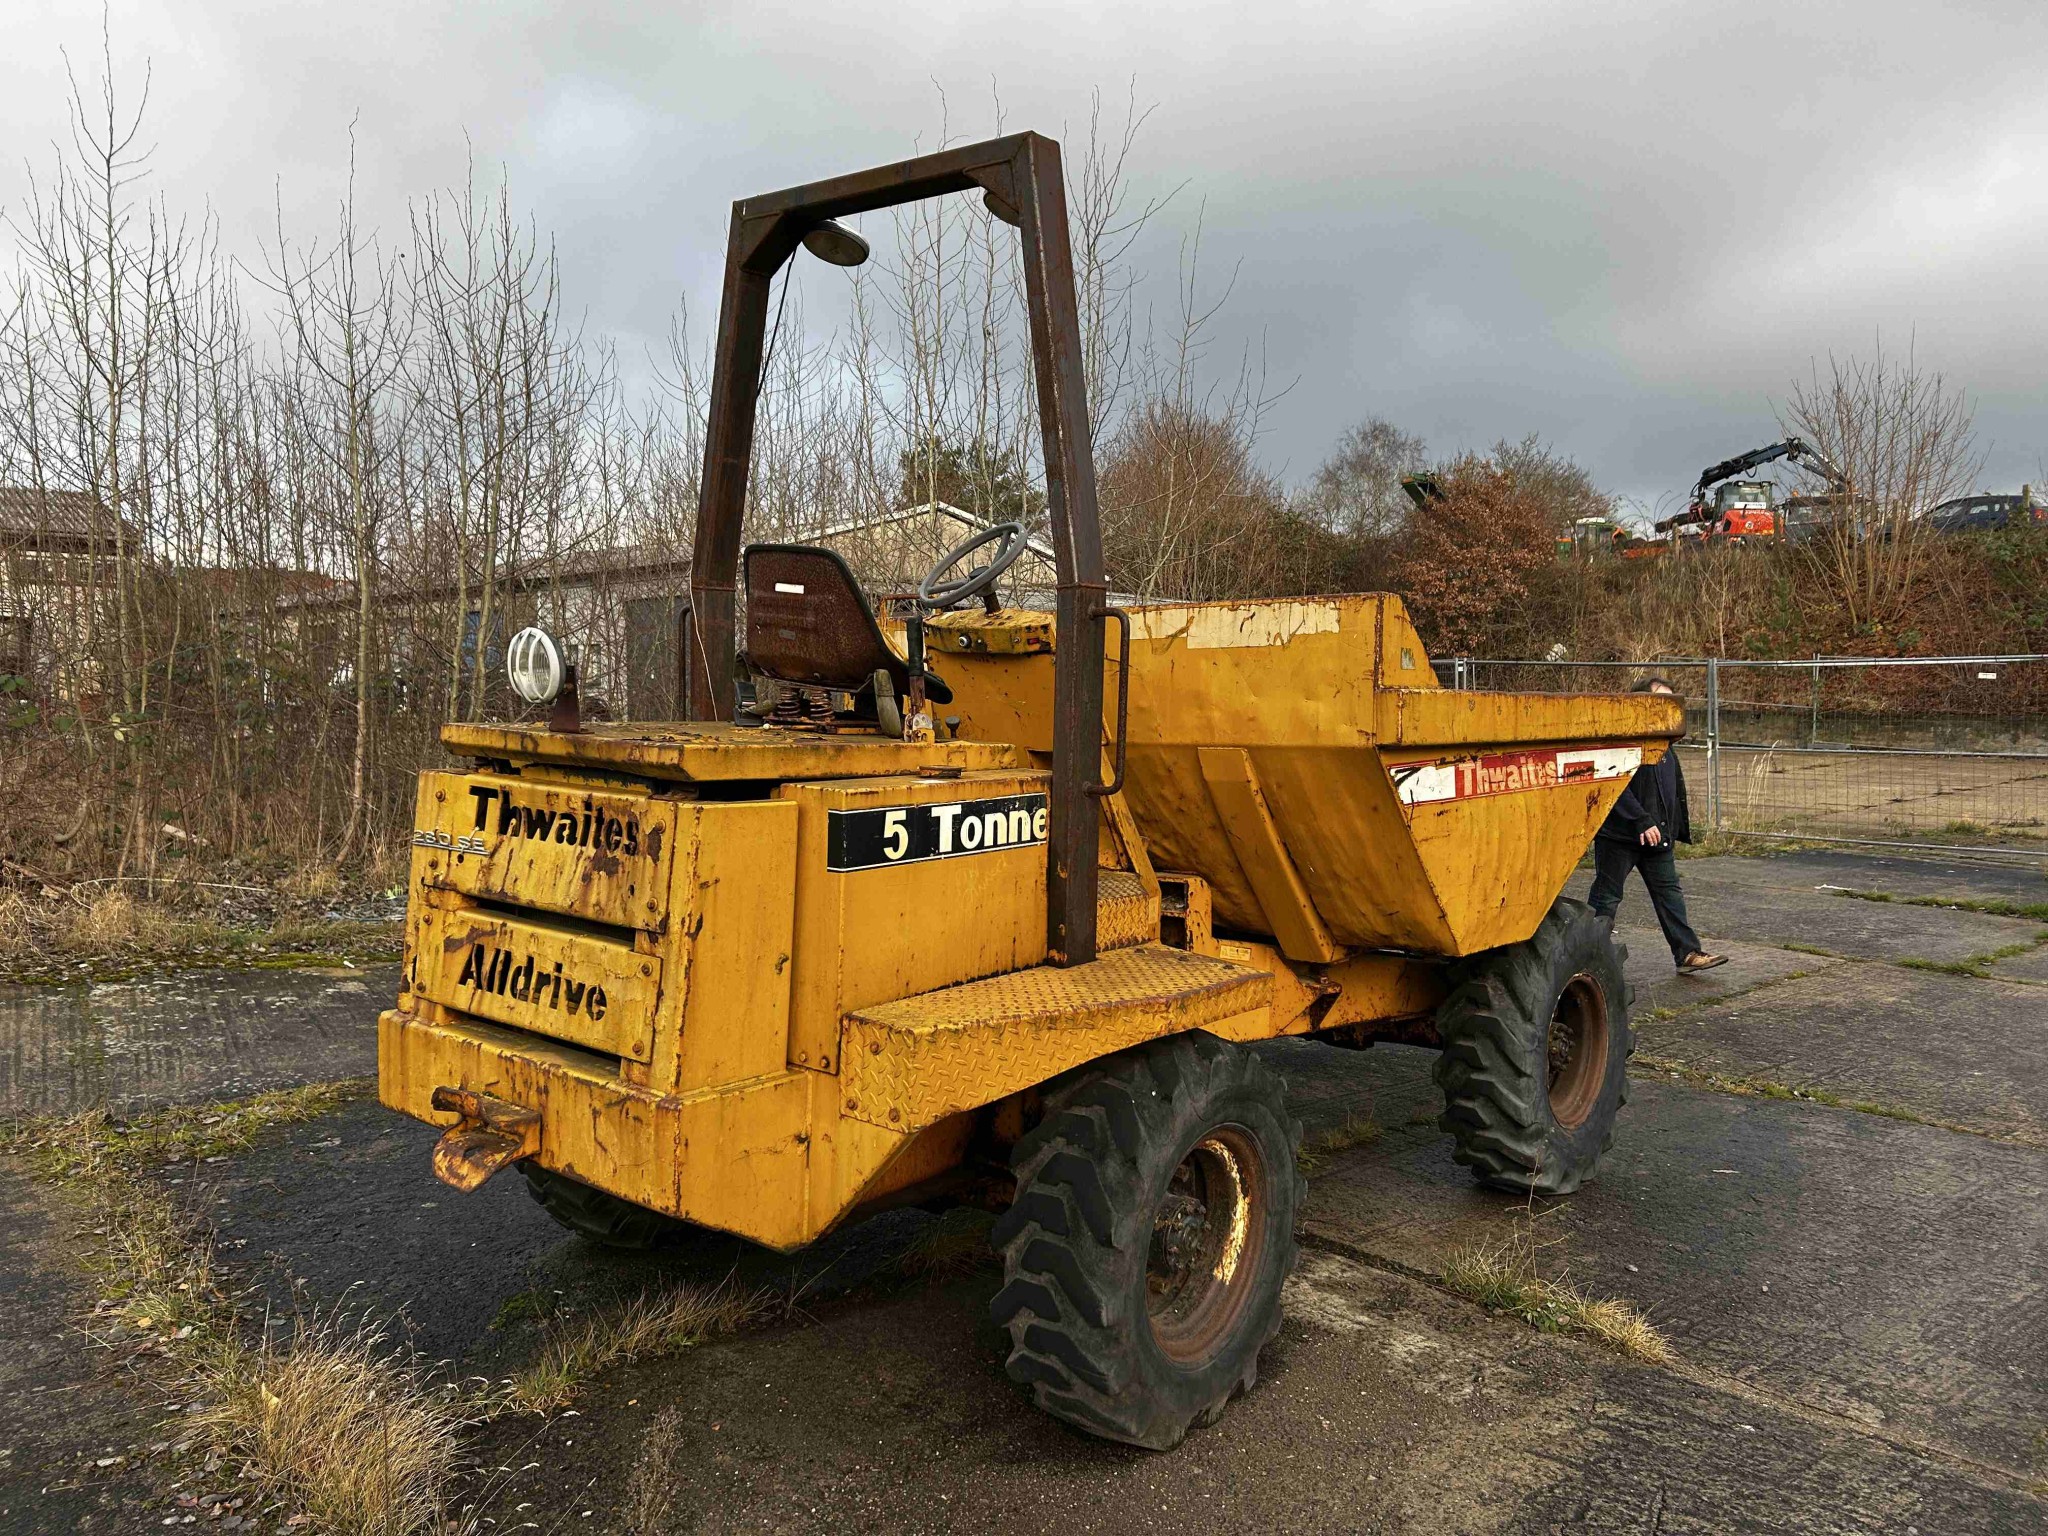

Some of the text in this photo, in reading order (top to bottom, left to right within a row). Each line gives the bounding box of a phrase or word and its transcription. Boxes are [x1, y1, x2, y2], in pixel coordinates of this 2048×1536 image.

[1458, 756, 1557, 796] Thwaites
[457, 835, 485, 851] SE
[469, 785, 640, 857] Thwaites
[883, 804, 1047, 860] 5 Tonne
[457, 943, 608, 1022] Alldrive
